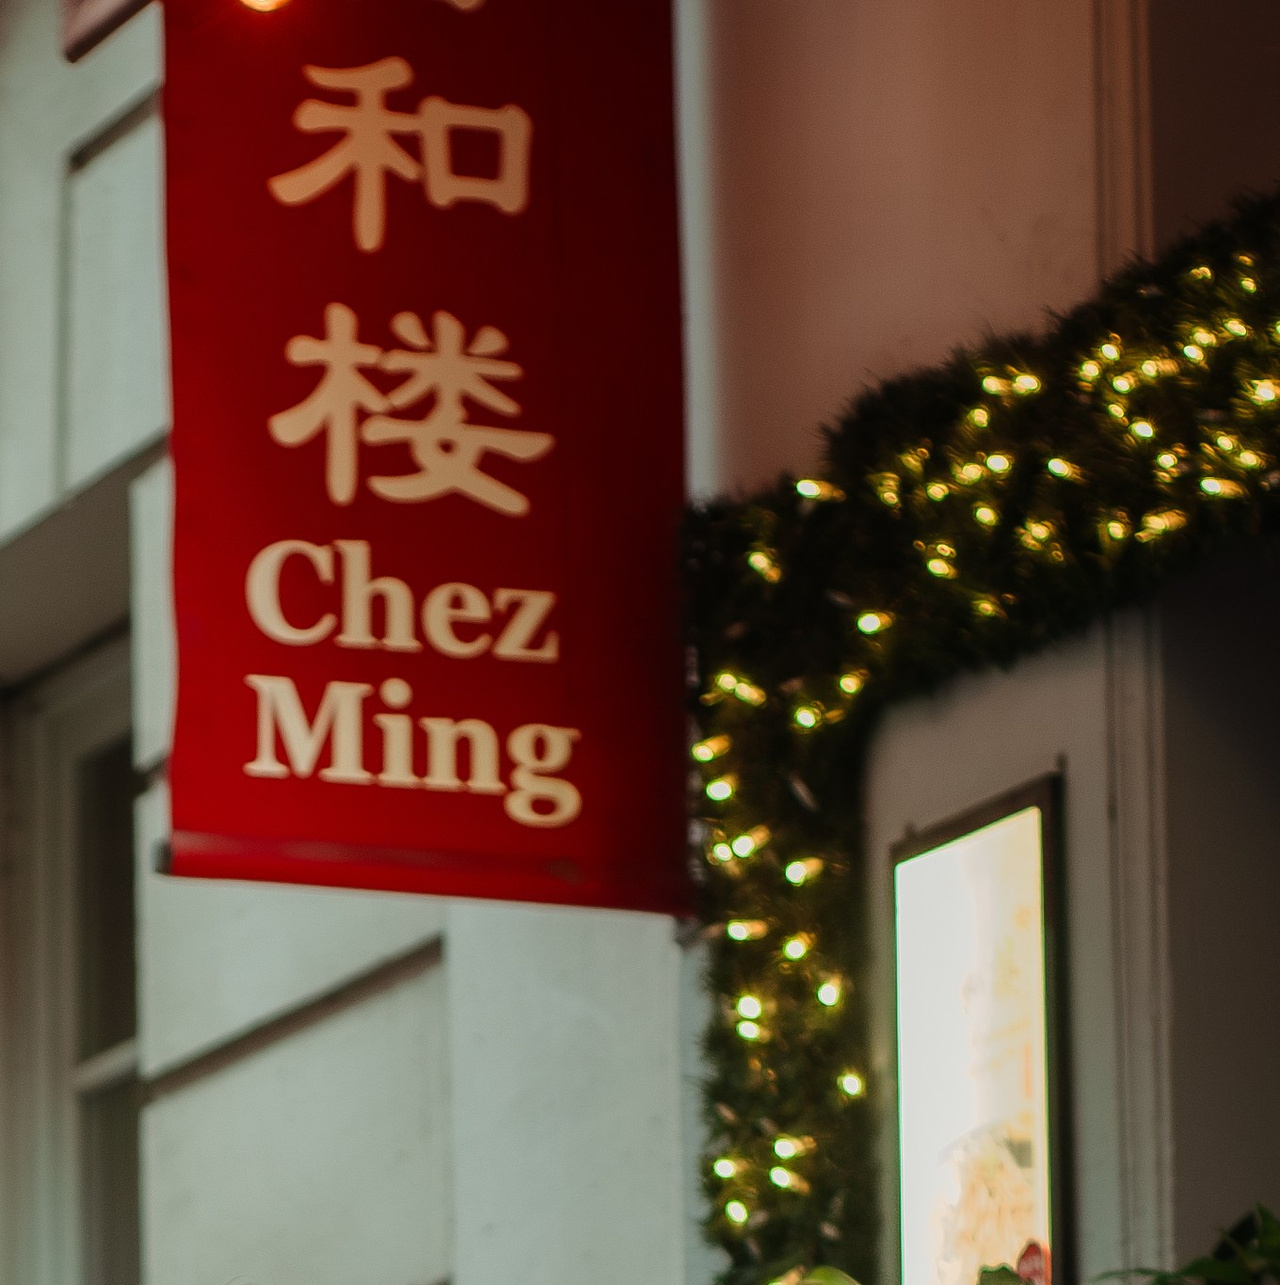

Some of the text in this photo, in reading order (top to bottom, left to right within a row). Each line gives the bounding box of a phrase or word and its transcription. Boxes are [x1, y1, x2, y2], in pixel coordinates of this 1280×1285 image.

[269, 0, 553, 516] 和楼
[244, 538, 560, 663] Chez
[243, 673, 582, 828] Ming
